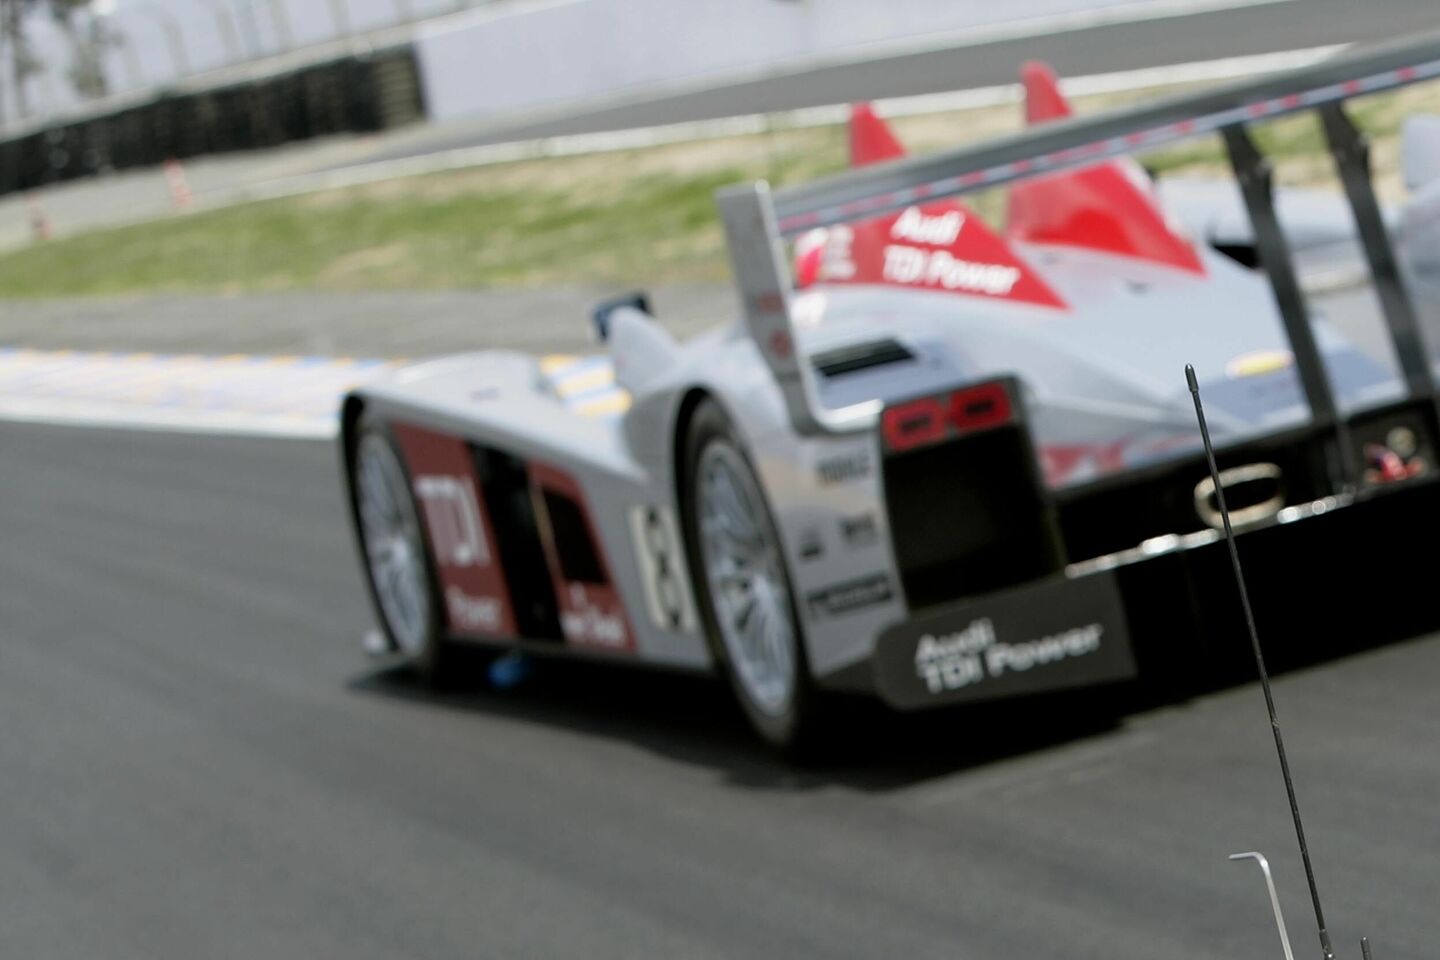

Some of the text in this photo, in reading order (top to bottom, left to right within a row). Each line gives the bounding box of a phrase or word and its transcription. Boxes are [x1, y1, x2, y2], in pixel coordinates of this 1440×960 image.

[890, 206, 965, 245] Audi
[930, 249, 1021, 295] Power
[916, 618, 995, 661] Audi
[917, 623, 1103, 693] TDI Power
